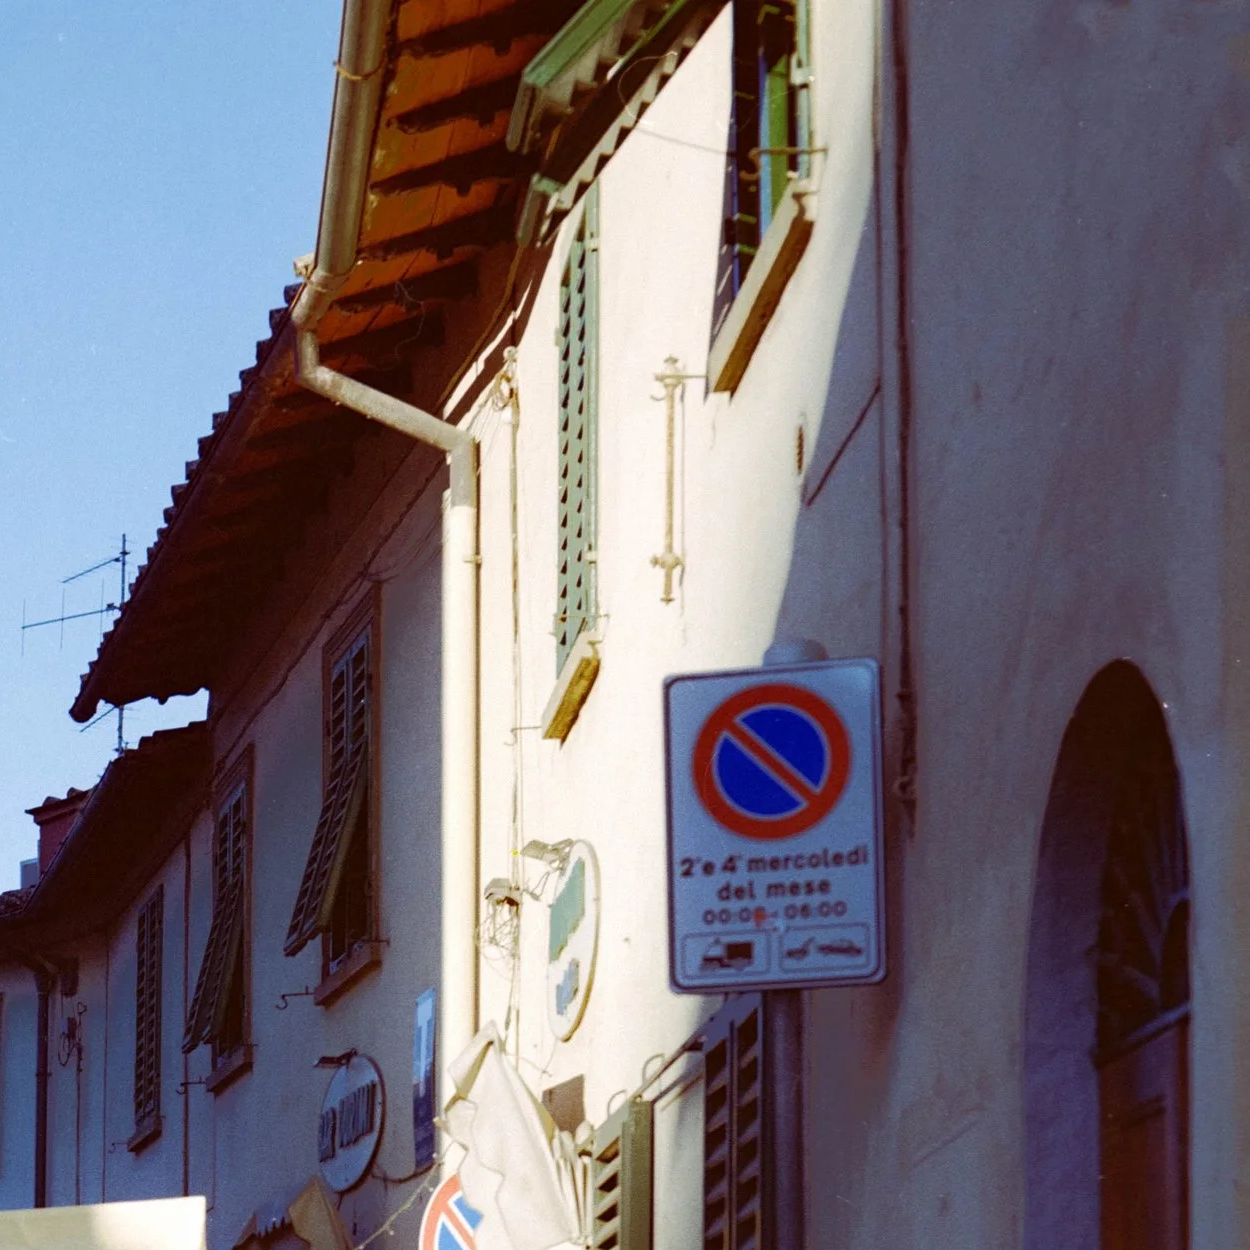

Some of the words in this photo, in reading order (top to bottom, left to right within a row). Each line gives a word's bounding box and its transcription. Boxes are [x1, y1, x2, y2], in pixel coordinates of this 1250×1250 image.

[702, 860, 716, 877] e
[717, 879, 756, 902] del
[765, 879, 831, 899] mese
